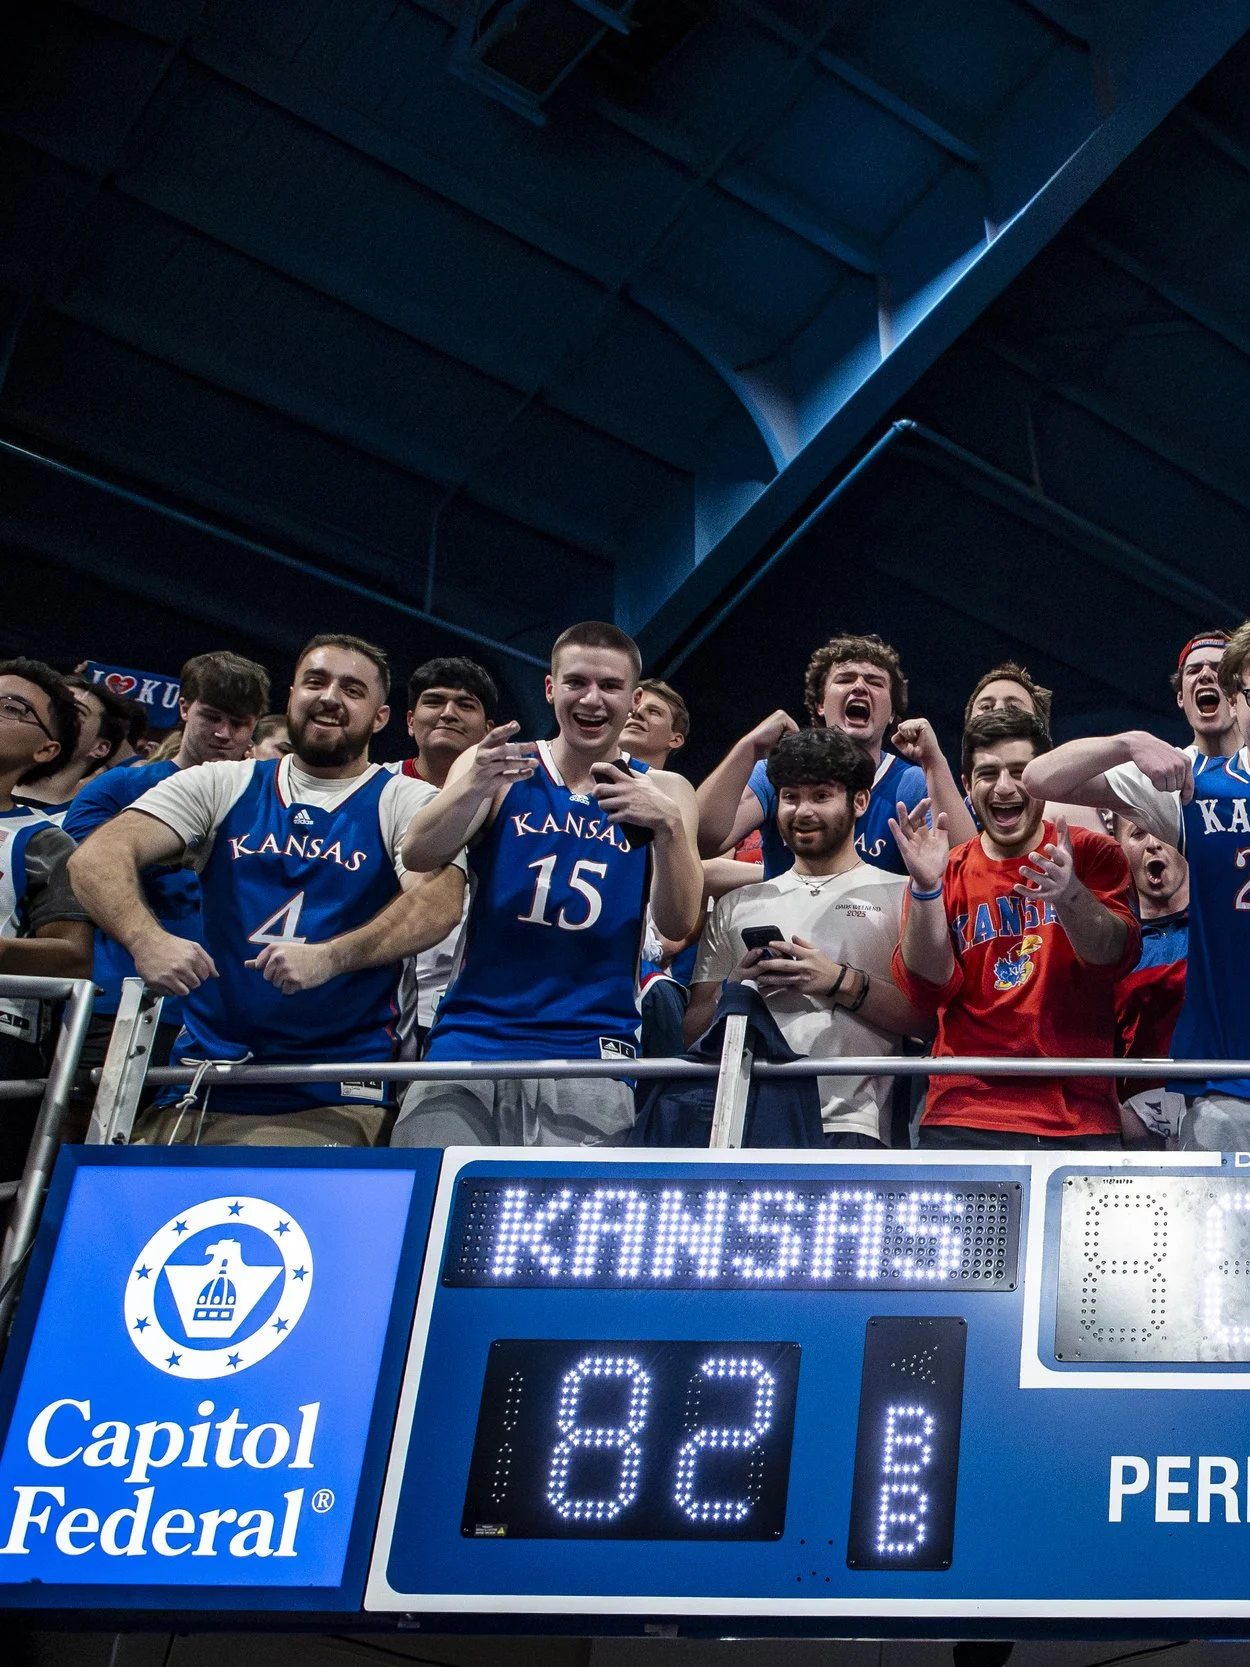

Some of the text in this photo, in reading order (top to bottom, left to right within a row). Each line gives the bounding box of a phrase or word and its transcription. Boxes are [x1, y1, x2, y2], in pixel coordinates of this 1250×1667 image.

[134, 678, 180, 708] KU
[228, 832, 368, 872] KANSAS
[247, 890, 307, 945] 4
[517, 853, 608, 931] 15
[490, 1186, 967, 1281] KANSAS
[26, 1398, 321, 1483] Capitol
[546, 1356, 776, 1521] 82
[882, 1406, 935, 1474] B
[876, 1484, 930, 1553] B
